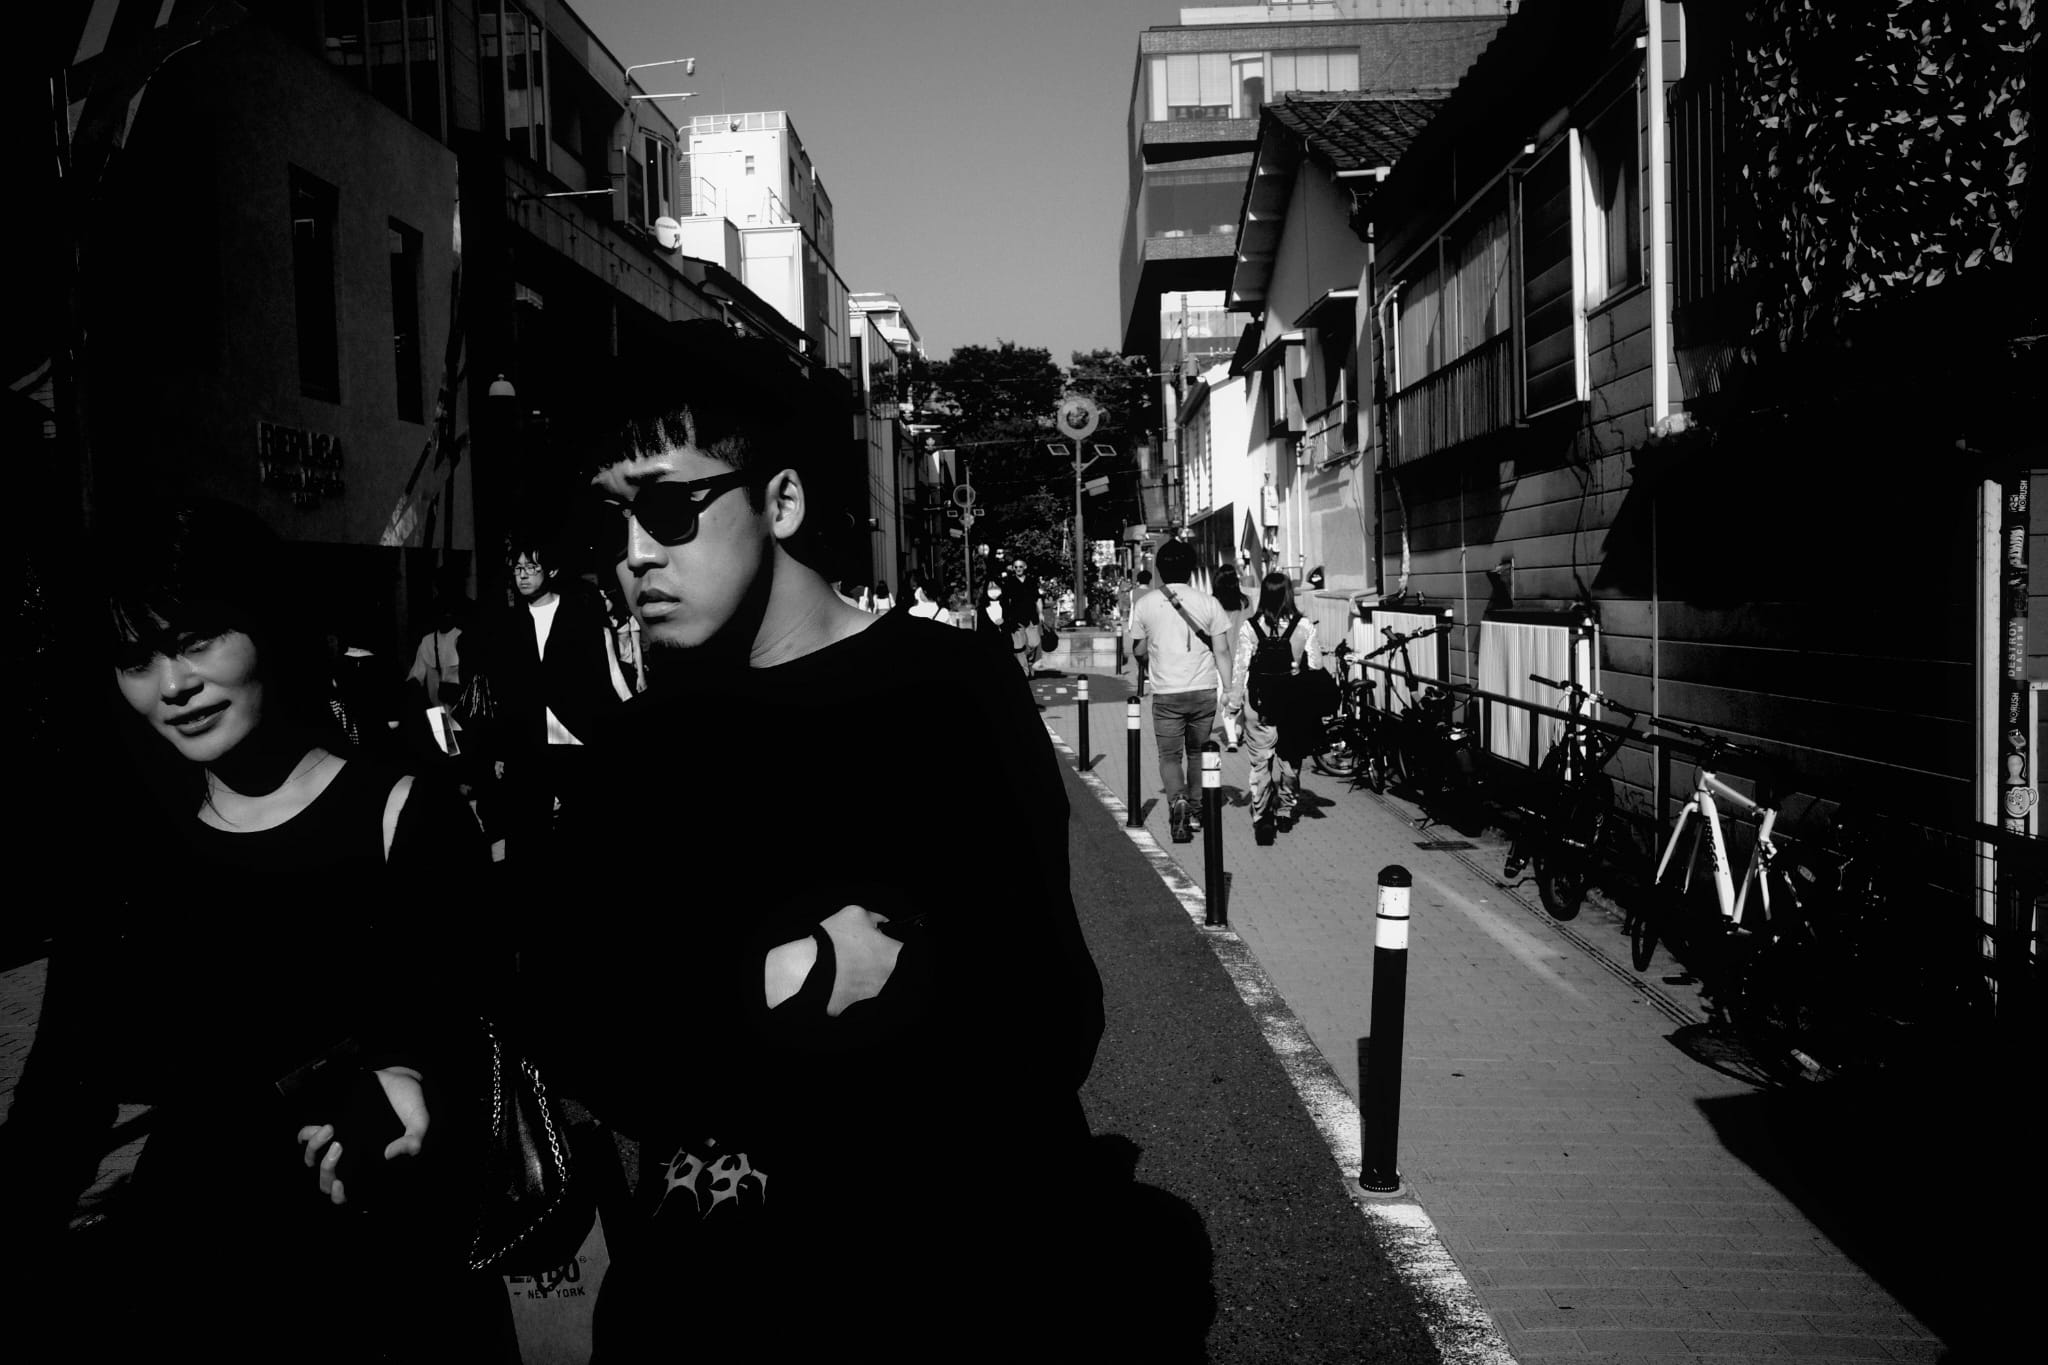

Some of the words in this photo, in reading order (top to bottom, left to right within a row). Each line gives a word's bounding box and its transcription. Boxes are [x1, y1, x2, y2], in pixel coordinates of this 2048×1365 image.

[2008, 621, 2017, 677] DESTROY
[2016, 626, 2024, 672] RACISM
[556, 1286, 586, 1299] YORK
